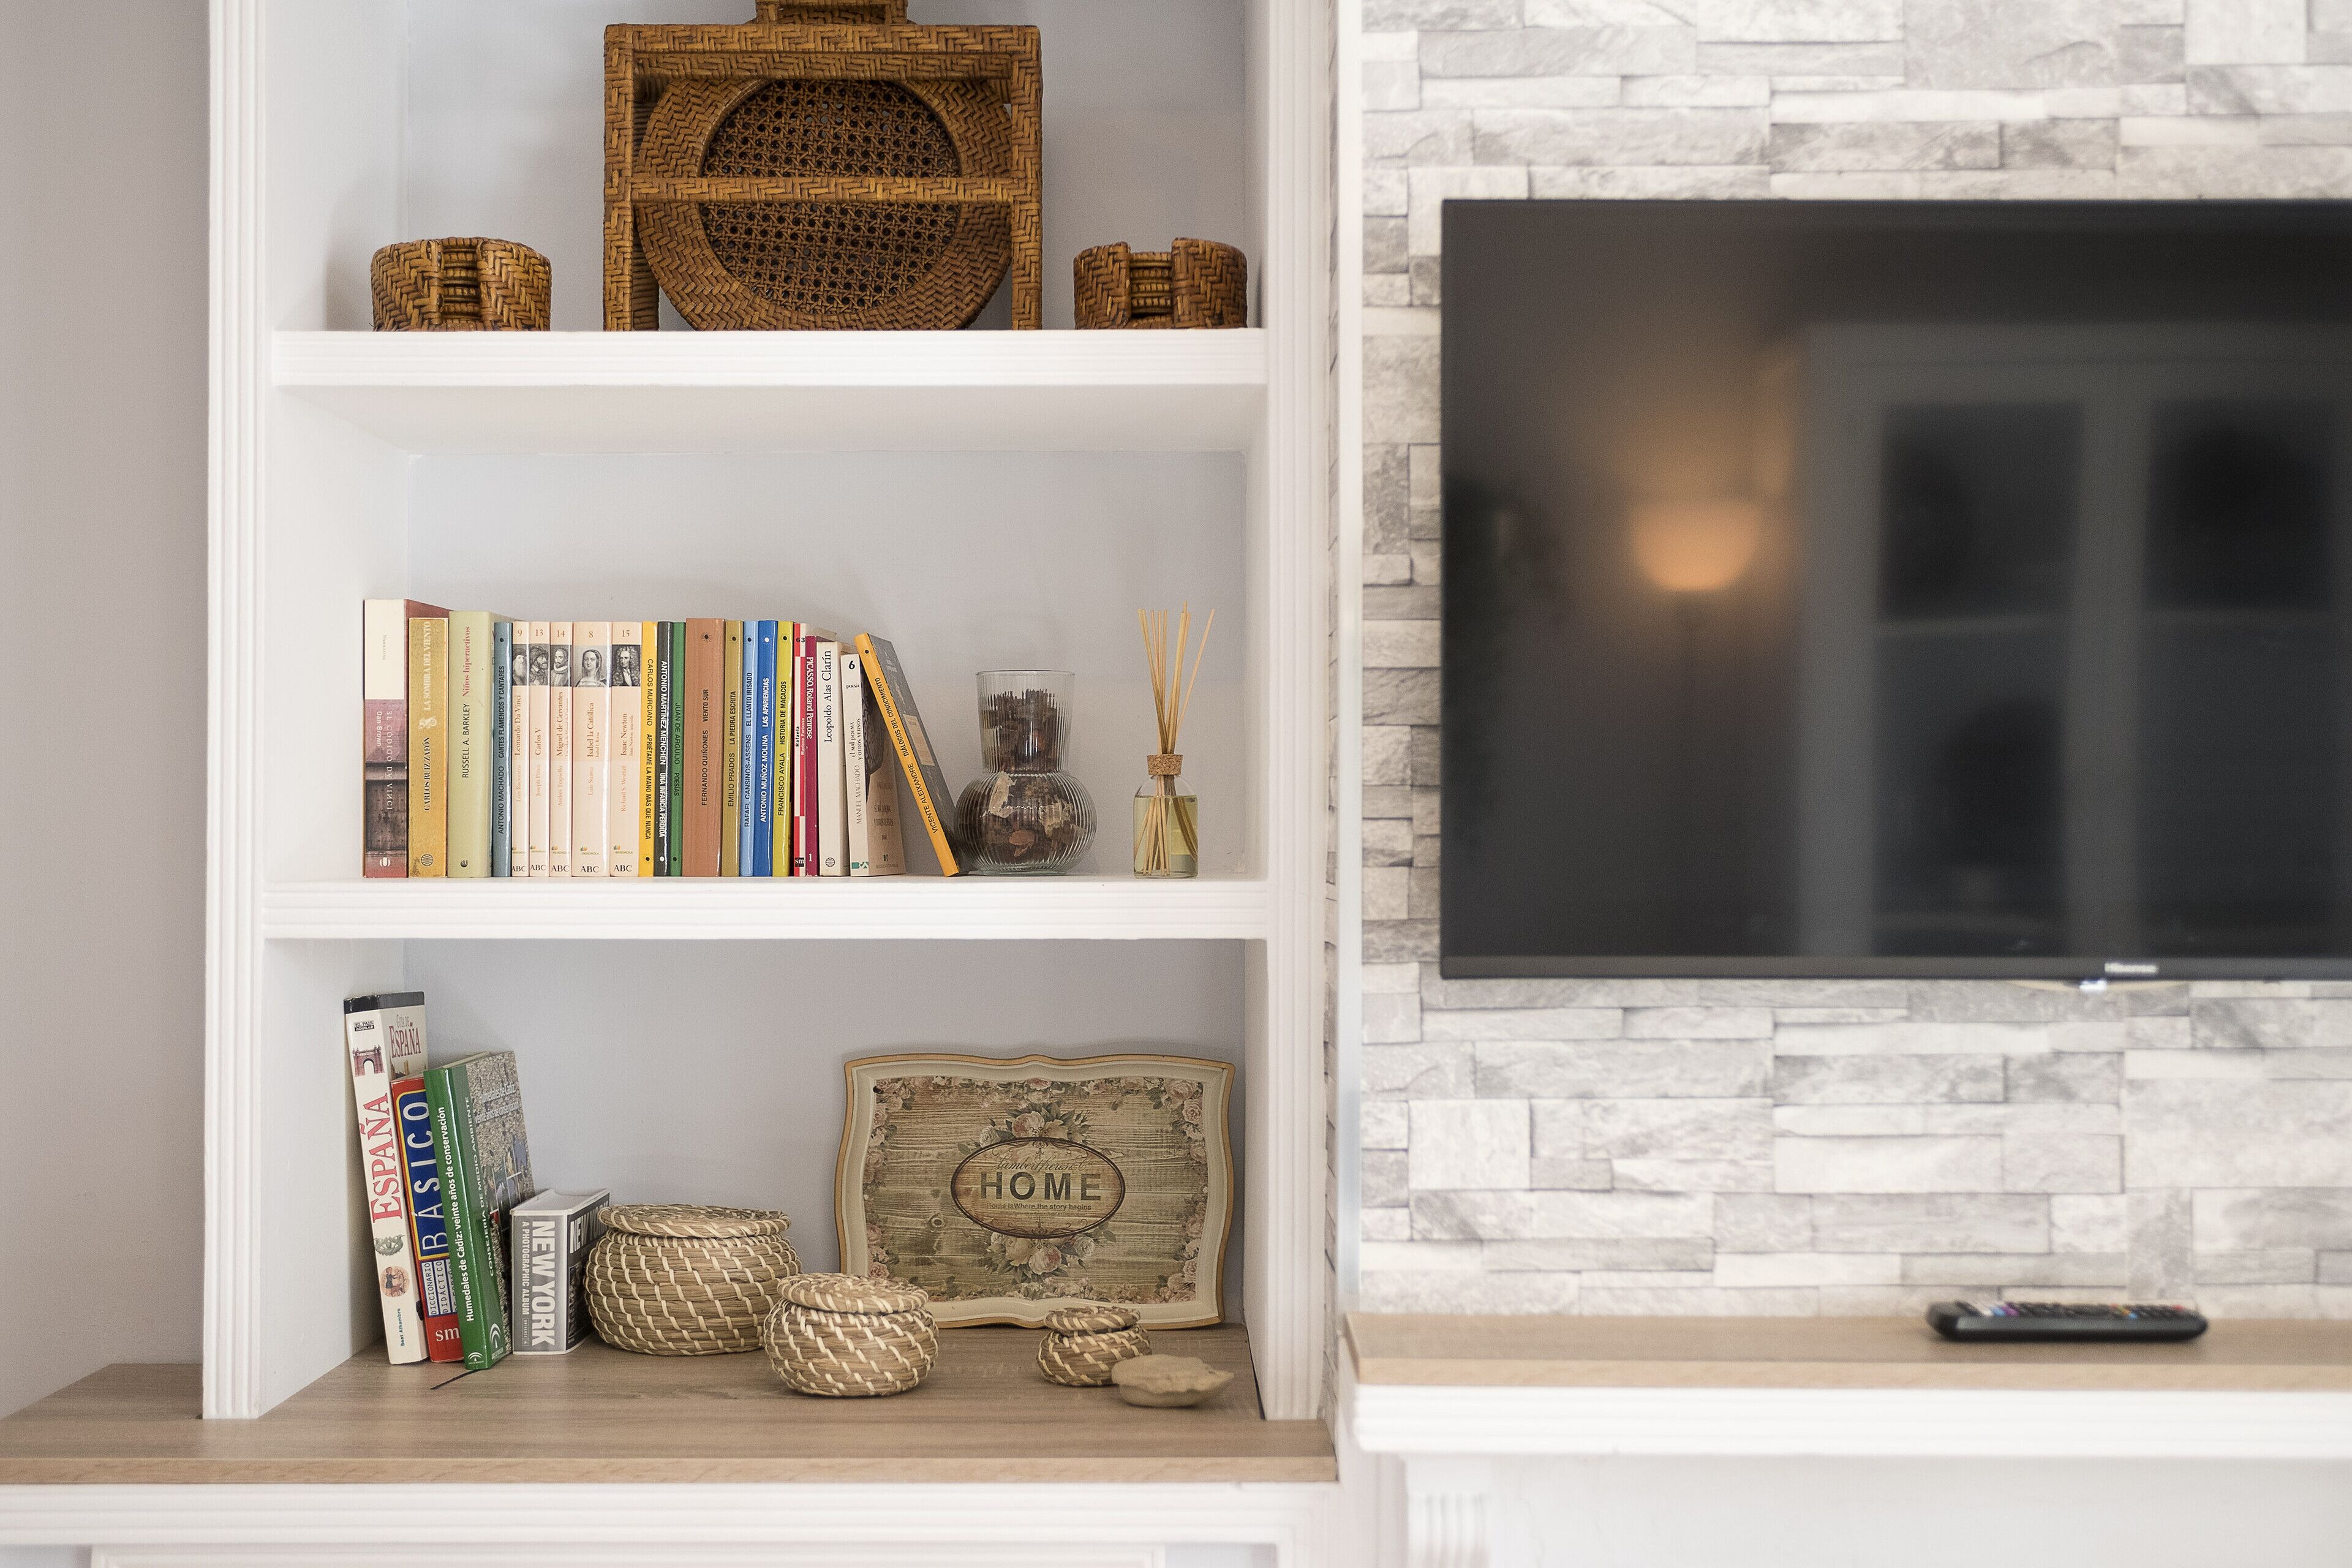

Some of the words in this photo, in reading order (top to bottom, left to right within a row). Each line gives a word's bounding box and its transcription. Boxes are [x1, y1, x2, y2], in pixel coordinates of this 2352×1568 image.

[462, 627, 472, 673] hiperactivos
[848, 660, 856, 670] 6
[821, 650, 832, 681] Clarín
[423, 700, 431, 710] LA
[875, 677, 894, 717] CONOCIMIENTO
[514, 712, 521, 723] Da
[674, 722, 681, 733] DE
[806, 712, 815, 739] Penrose
[824, 705, 834, 743] Leopoldo
[421, 737, 431, 761] ZAFÓN
[893, 728, 910, 757] DIÁLOGOS
[908, 763, 929, 804] ALEIXANDRE
[924, 804, 938, 834] VICENTE
[809, 853, 813, 862] 1
[389, 1022, 421, 1058] ESPAÑA
[437, 1106, 453, 1165] conservación
[464, 1096, 477, 1152] AMBIENTE
[360, 1093, 402, 1223] ESPAÑA
[445, 1166, 454, 1178] de
[403, 1102, 448, 1251] BÁSICO
[448, 1178, 458, 1200] años
[980, 1171, 1101, 1201] HOME
[450, 1201, 462, 1229] veinte
[479, 1193, 484, 1208] DE
[453, 1229, 466, 1259] Cádiz:
[481, 1210, 494, 1276] CONSEJERÍA
[532, 1221, 556, 1277] NEW
[458, 1261, 467, 1273] de
[426, 1262, 437, 1315] DICCIONARIO
[436, 1261, 449, 1313] DIDÁCTICO
[460, 1276, 474, 1321] Humedales
[531, 1281, 556, 1346] YORK
[435, 1327, 460, 1342] sm
